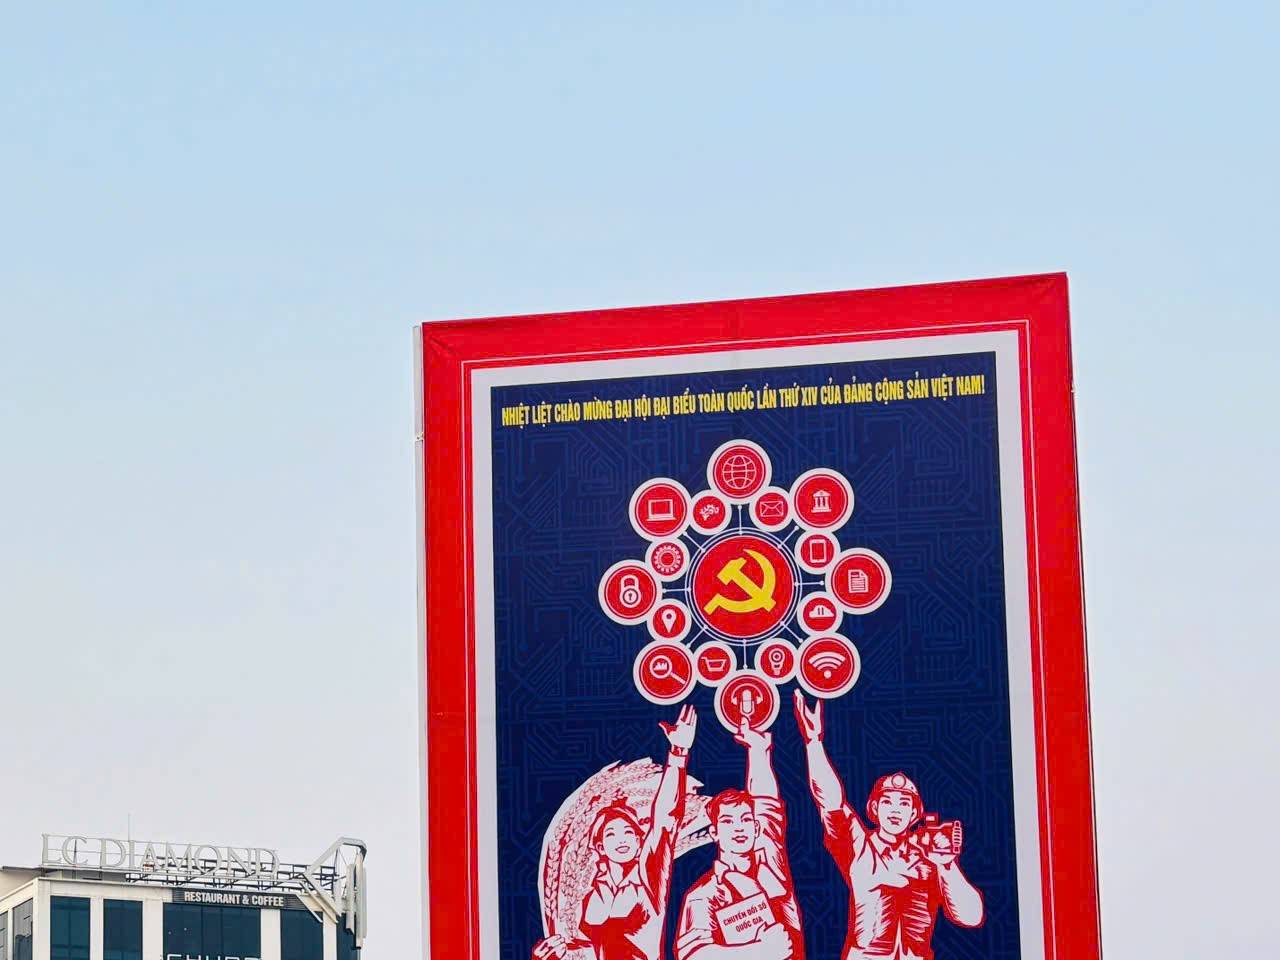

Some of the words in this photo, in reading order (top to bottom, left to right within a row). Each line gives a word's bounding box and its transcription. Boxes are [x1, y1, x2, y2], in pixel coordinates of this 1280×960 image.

[502, 402, 530, 429] NHIỆT
[532, 401, 552, 428] LIỆT
[554, 399, 581, 423] CHÀO
[583, 397, 613, 421] MỪNG
[614, 399, 632, 422] ĐẠI
[634, 394, 652, 421] HỘI
[653, 397, 671, 420] ĐẠI
[673, 387, 696, 415] BIỂU
[698, 389, 725, 412] TOÀN
[727, 384, 755, 413] QUỐC
[756, 382, 777, 410] LẦN
[779, 382, 800, 408] THỨ
[801, 386, 819, 407] XIV
[820, 376, 842, 405] CỦA
[843, 375, 873, 404] ĐẢNG
[875, 377, 905, 405] CỘNG
[906, 371, 929, 400] SẢN
[931, 373, 954, 401] VIỆT
[955, 374, 985, 396] NAM!
[99, 838, 281, 880] DIAMOND
[184, 891, 241, 905] RESTAURANT
[242, 894, 250, 905] &
[251, 894, 284, 907] COFFEE
